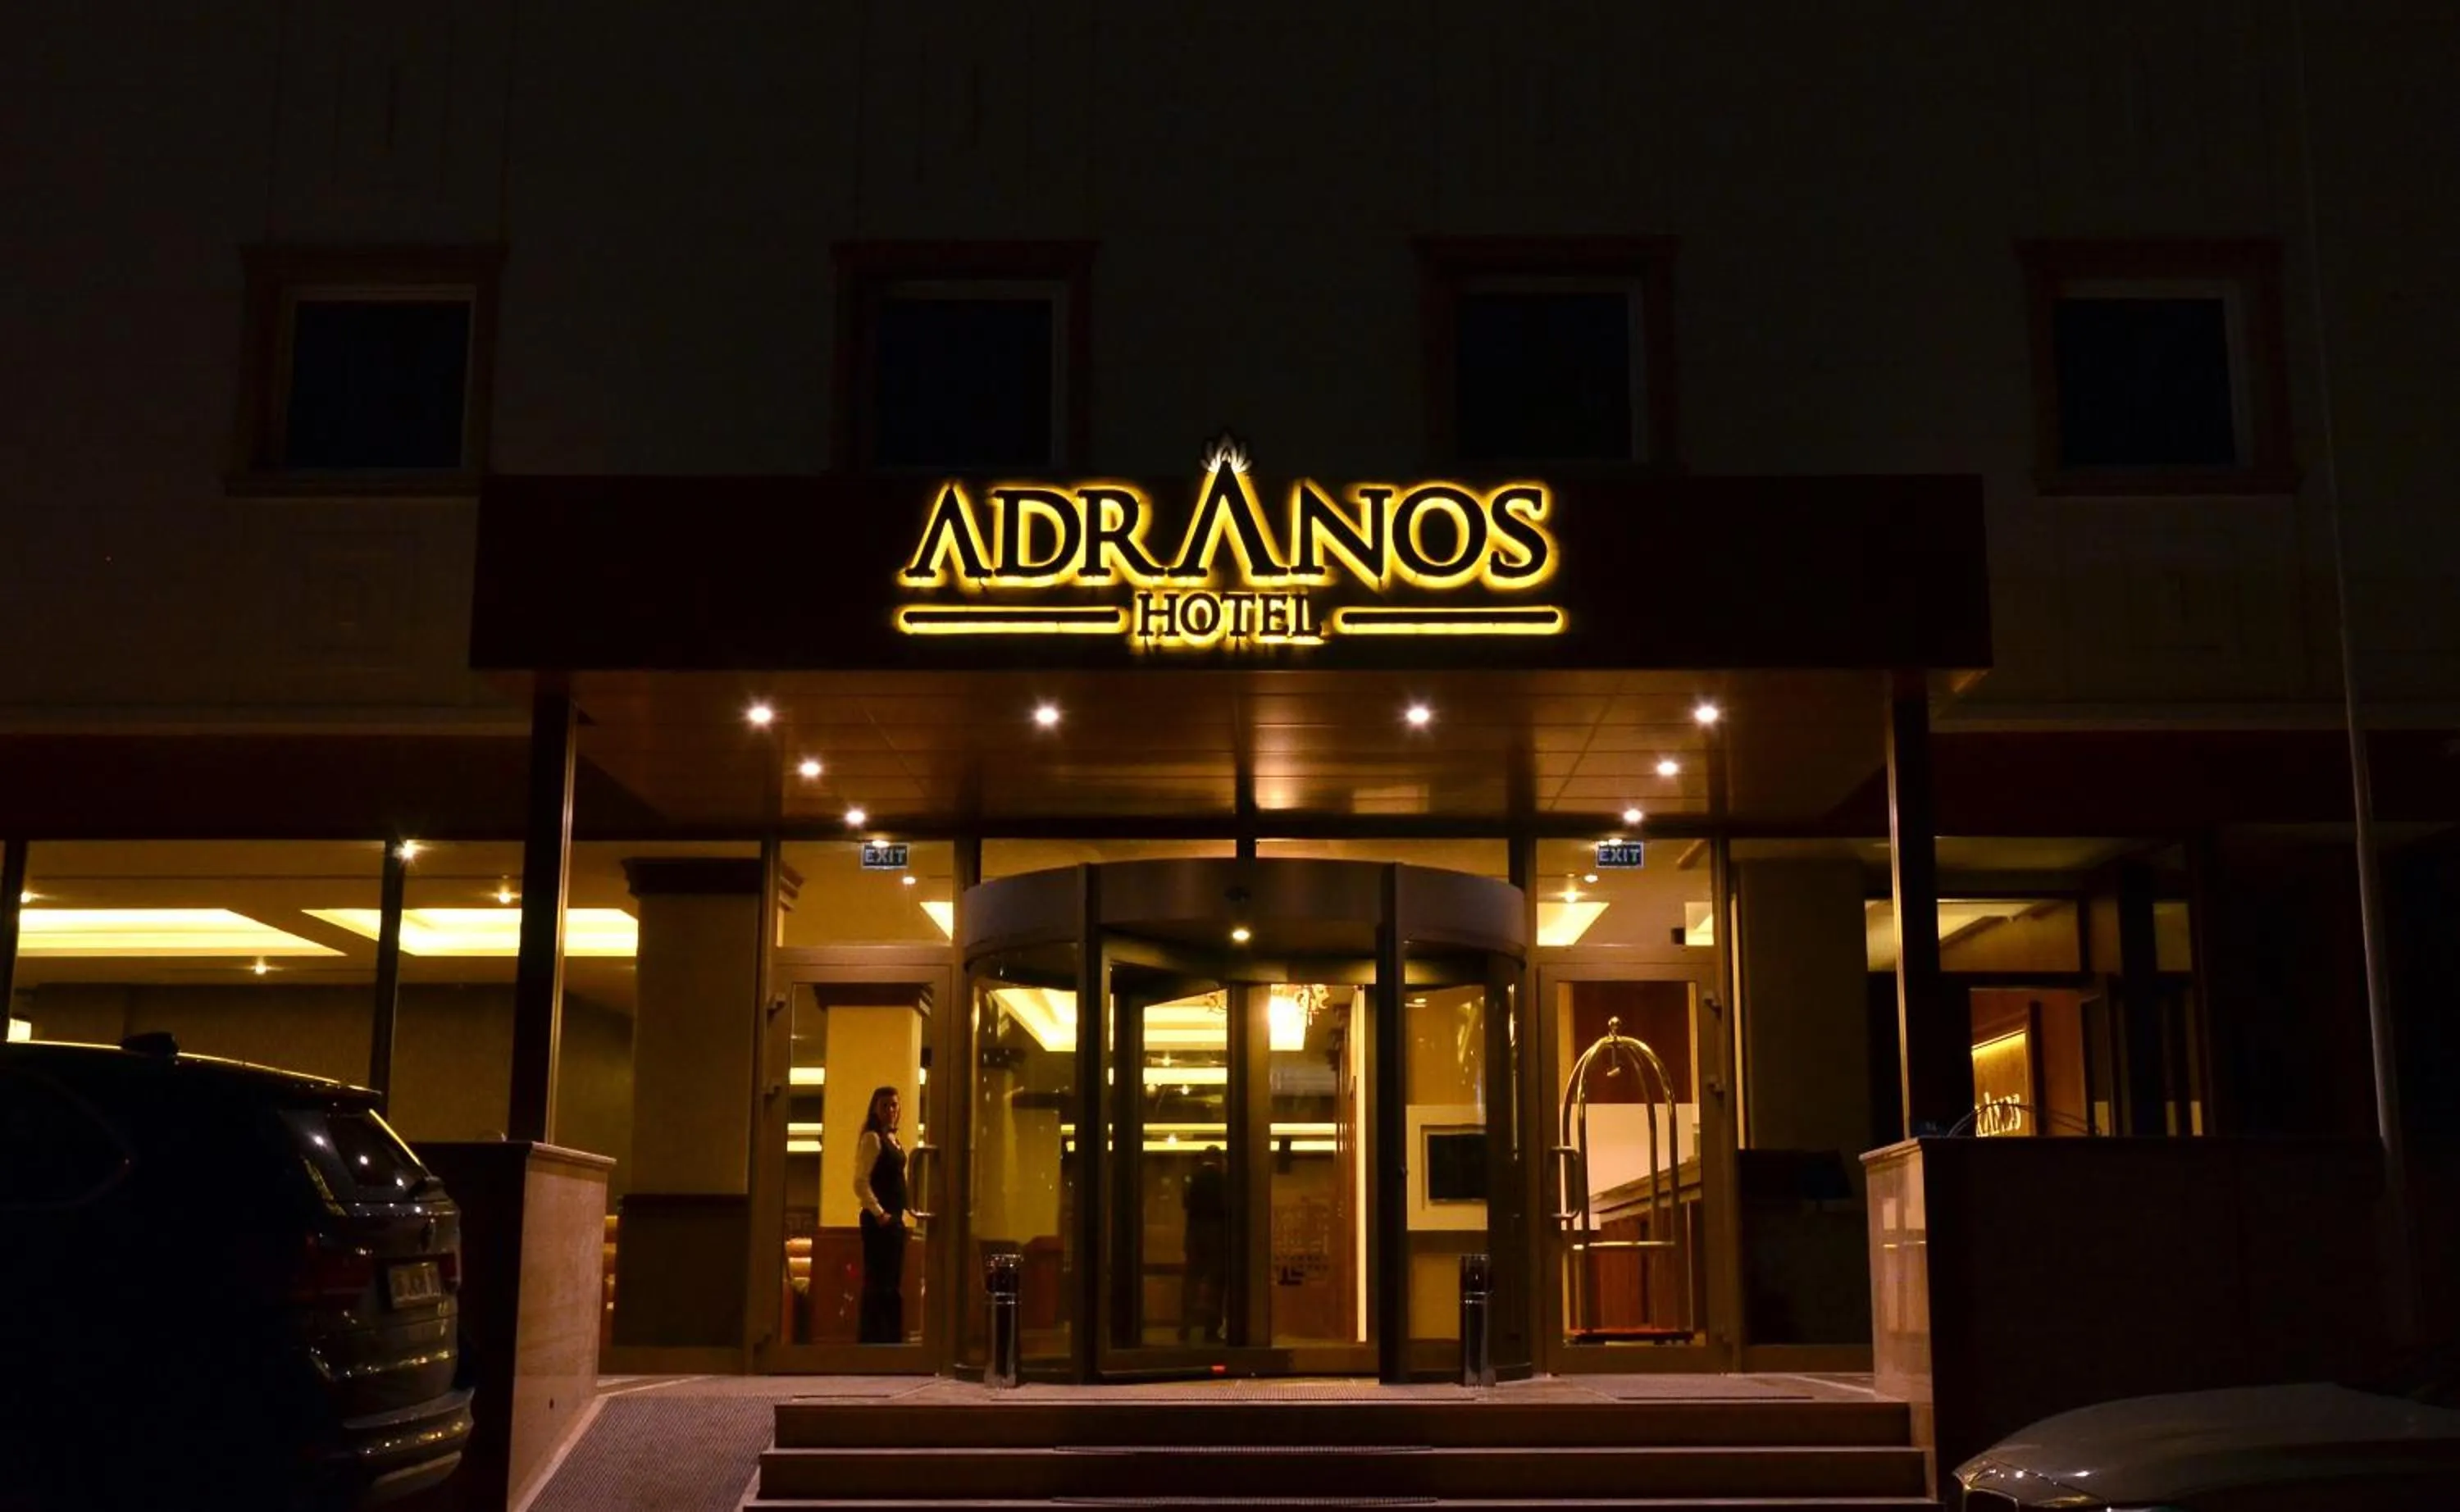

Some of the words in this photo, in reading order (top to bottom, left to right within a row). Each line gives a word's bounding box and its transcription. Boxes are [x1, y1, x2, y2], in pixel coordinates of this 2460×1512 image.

[904, 461, 1550, 581] ADRANOS
[1135, 591, 1323, 640] HOTEL
[865, 848, 906, 863] EXIT
[1599, 848, 1639, 863] EXIT
